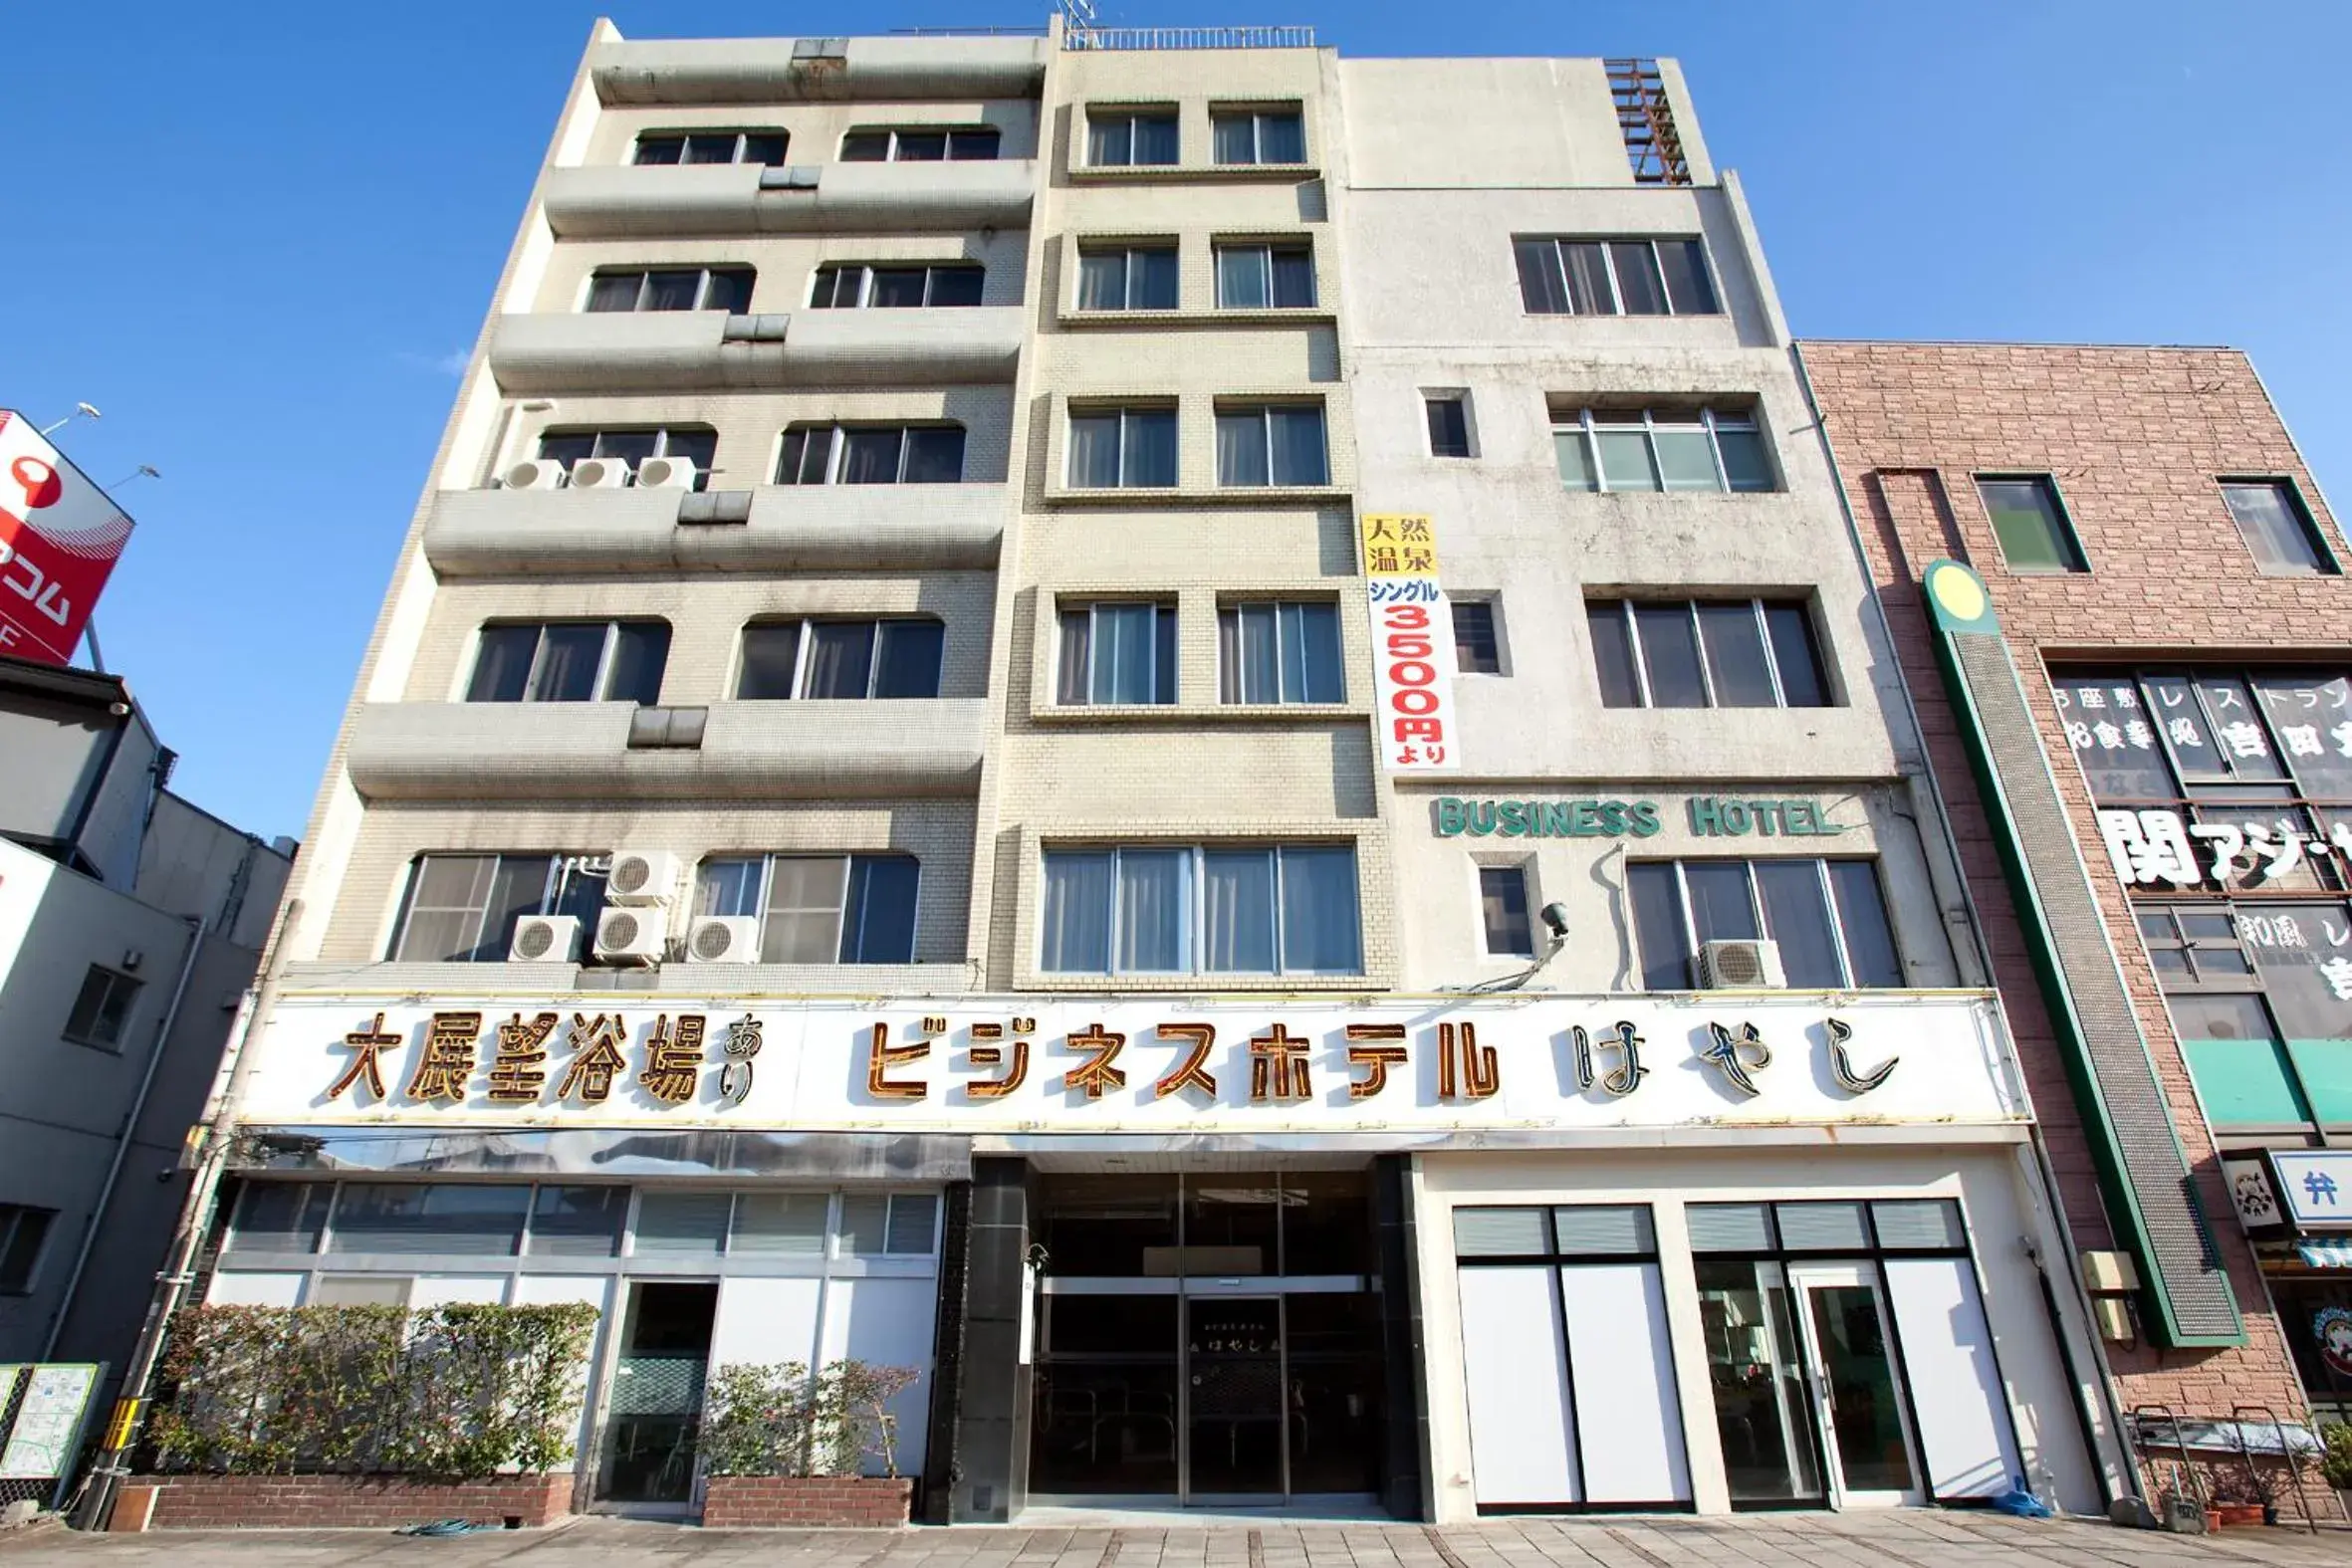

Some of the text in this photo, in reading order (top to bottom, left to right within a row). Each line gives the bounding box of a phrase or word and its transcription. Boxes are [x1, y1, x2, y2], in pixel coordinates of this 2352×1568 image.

[1367, 519, 1430, 542] 天然
[1369, 547, 1433, 572] 温泉
[1370, 578, 1440, 602] シングル
[1396, 745, 1445, 765] より
[1436, 796, 1845, 838] BUSINESS HOTEL
[329, 1011, 764, 1106] 大展望浴場 あり
[868, 1016, 1900, 1100] ビジネスホテル はやし
